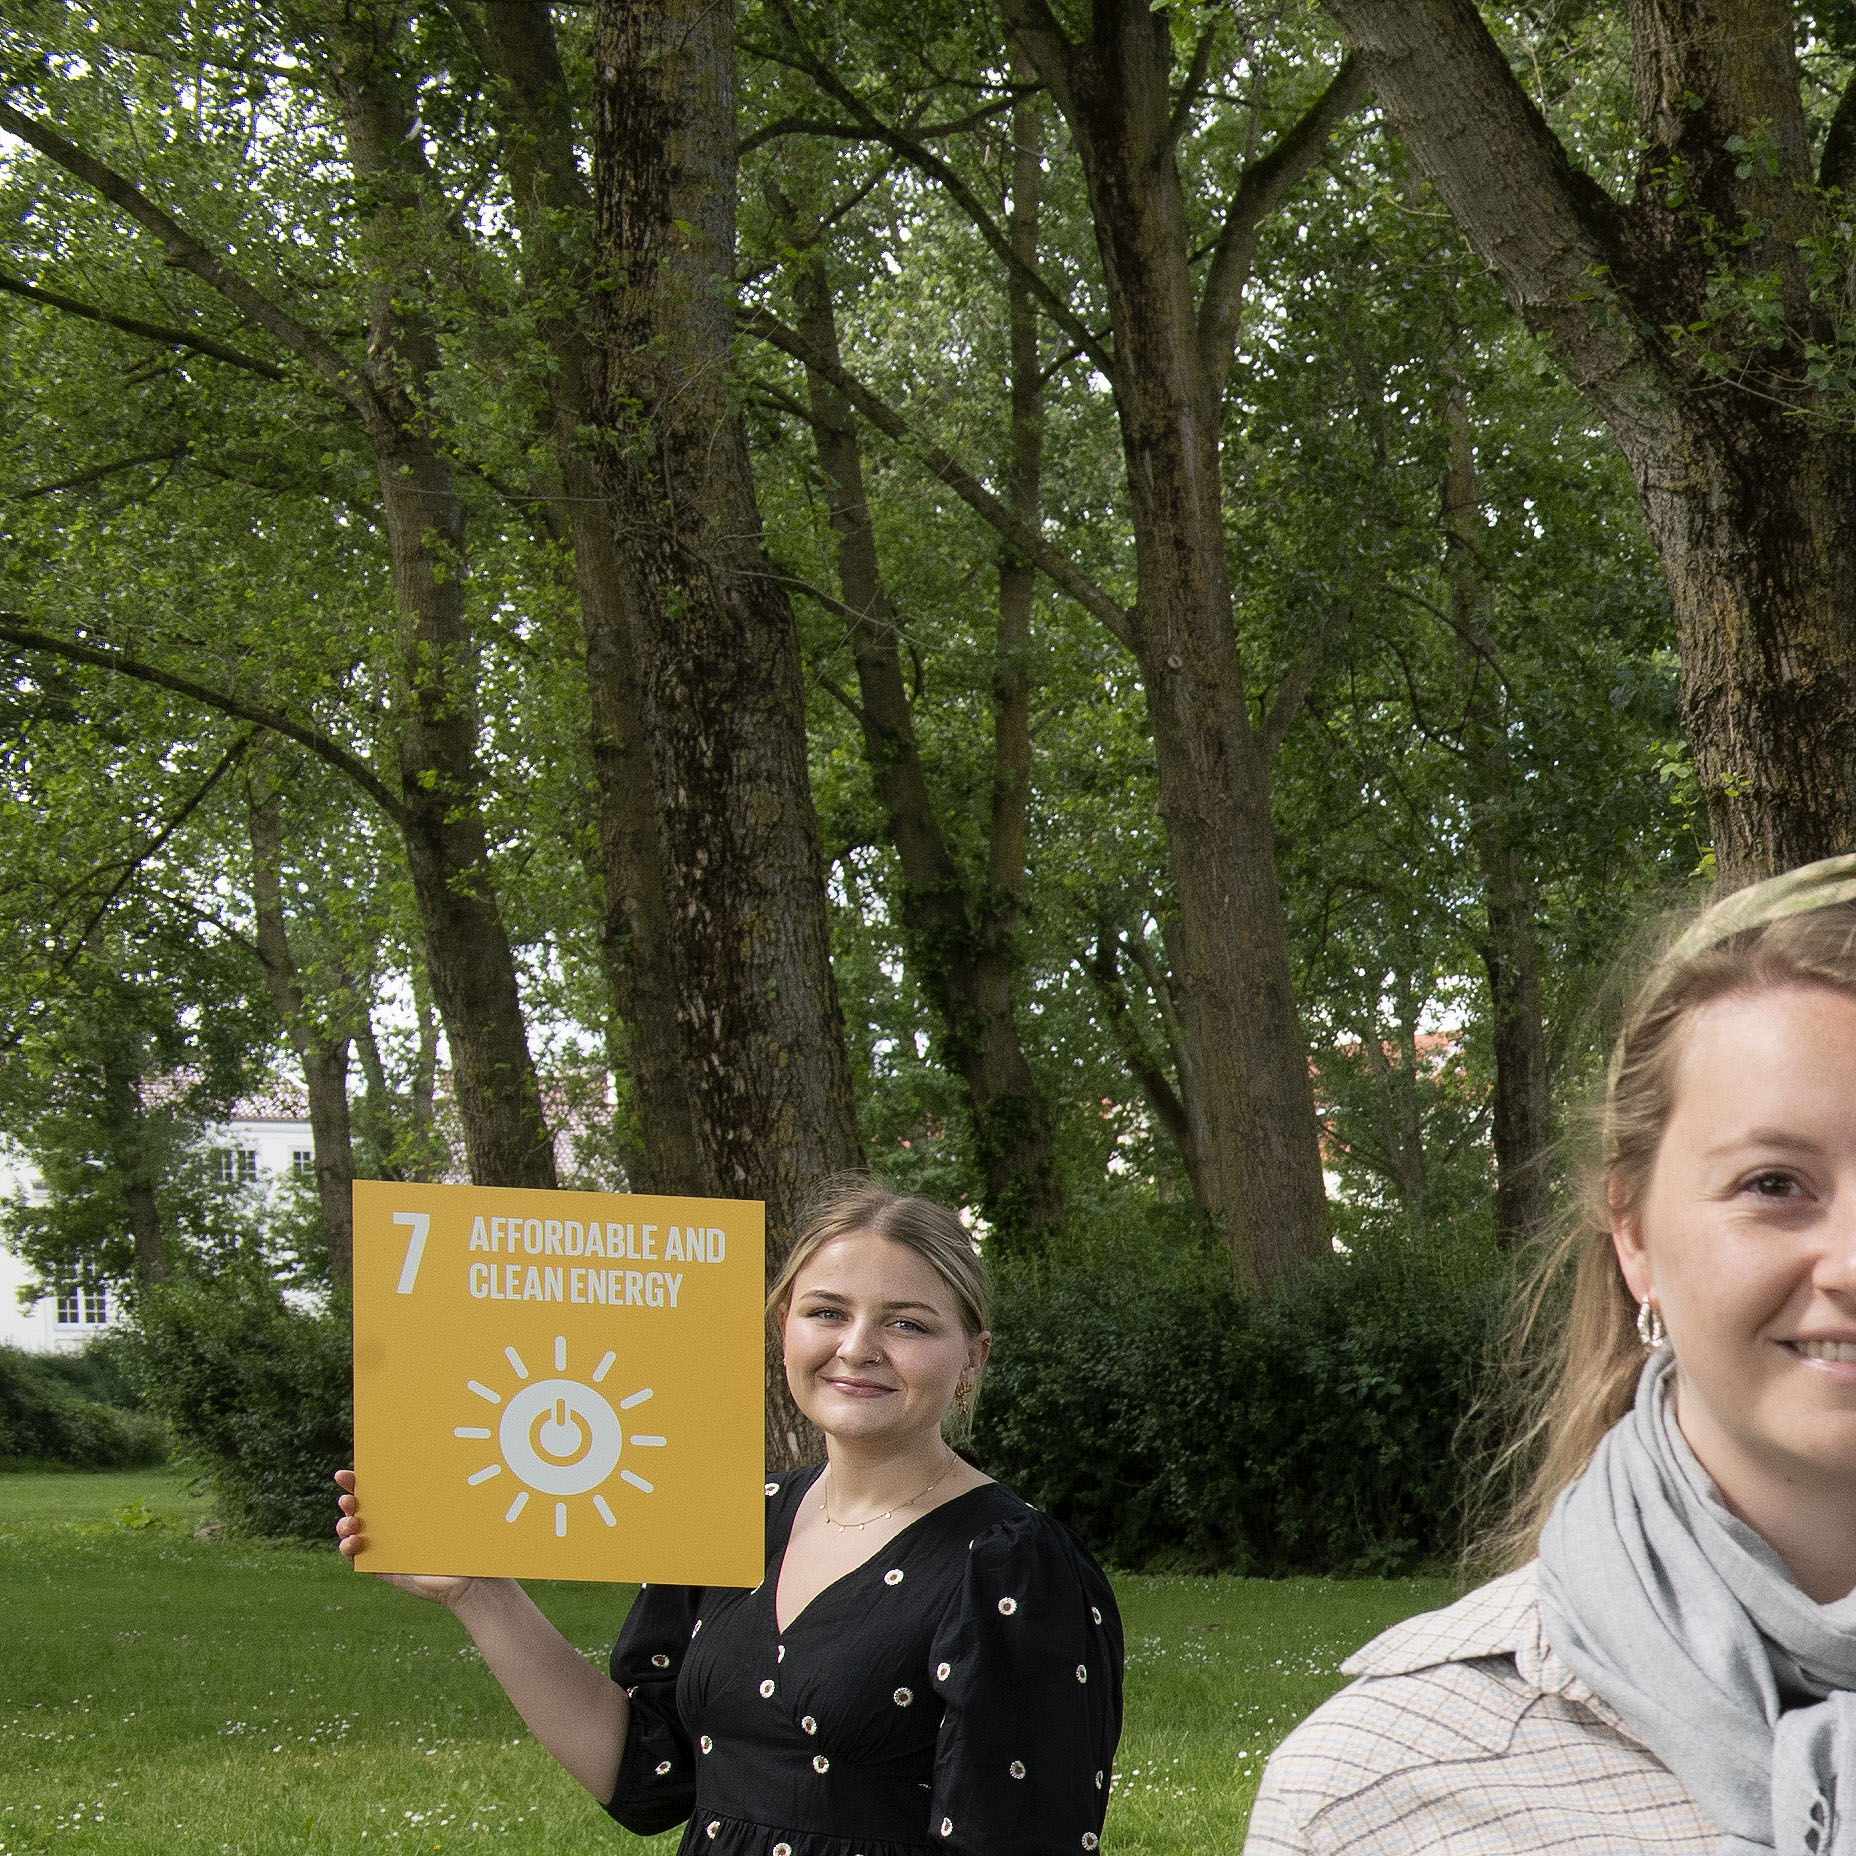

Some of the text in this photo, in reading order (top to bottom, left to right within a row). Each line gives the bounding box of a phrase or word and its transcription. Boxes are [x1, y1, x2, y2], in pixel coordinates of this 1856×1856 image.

[393, 1213, 430, 1294] 7
[469, 1217, 726, 1263] AFFORDABLE AND
[469, 1263, 683, 1308] CLEAN ENERGY
